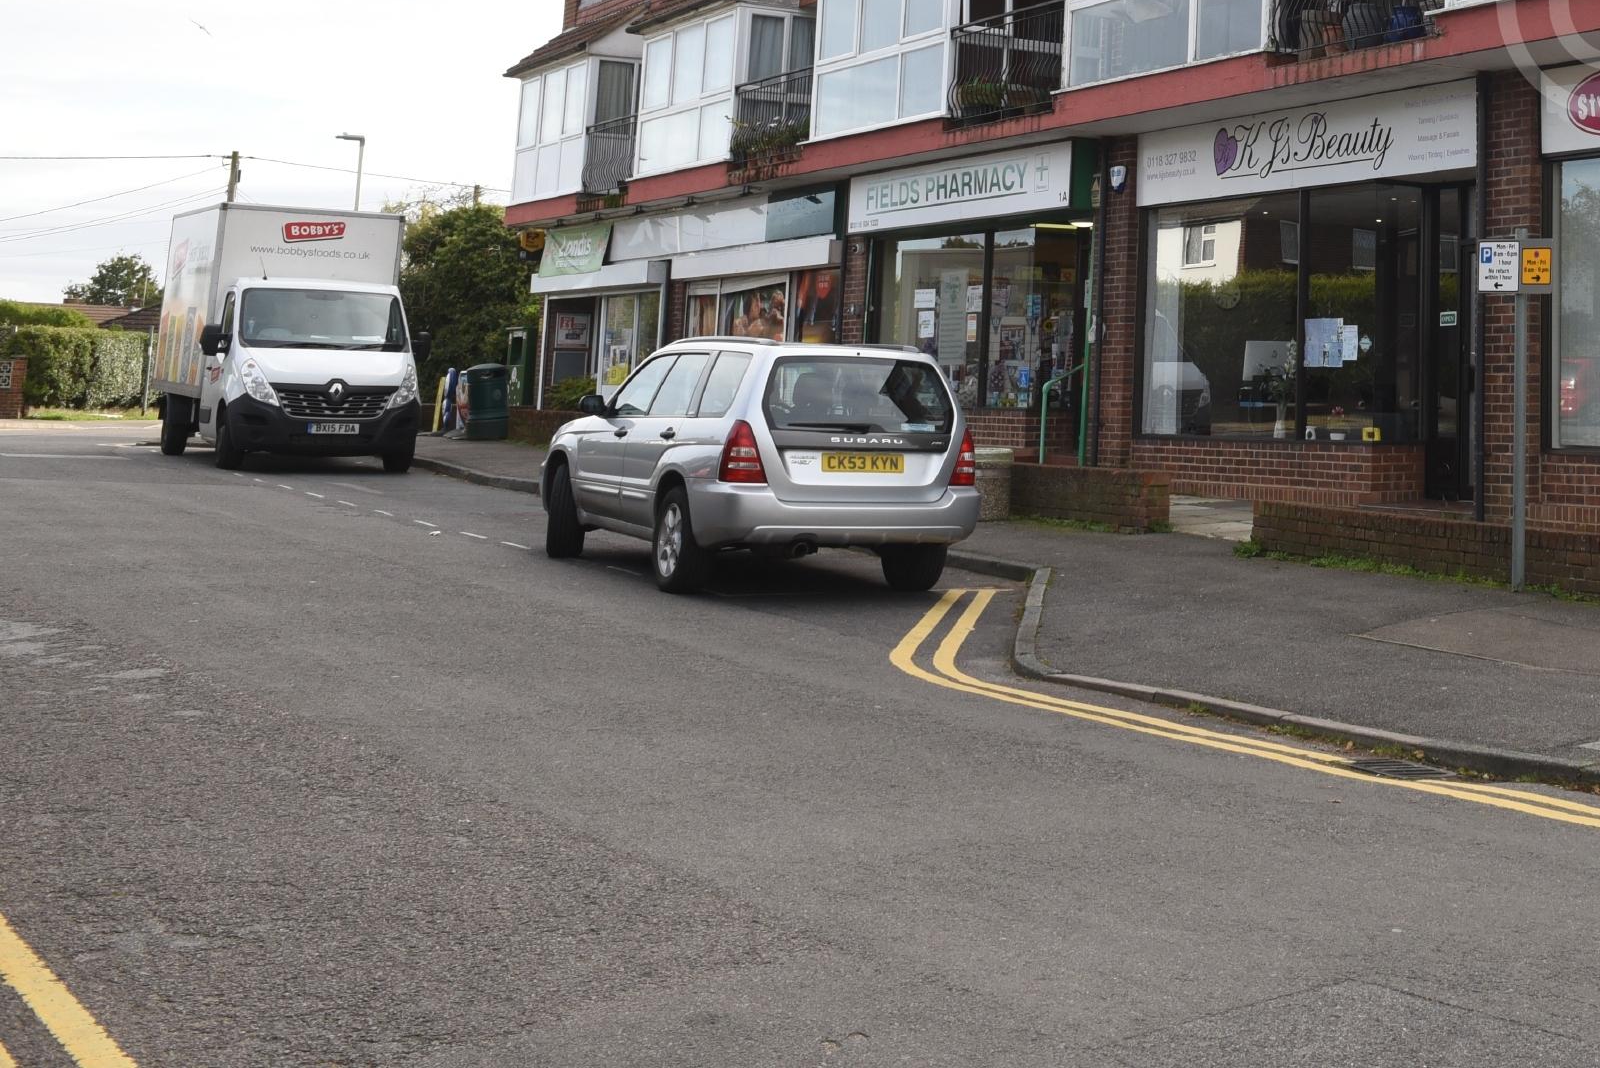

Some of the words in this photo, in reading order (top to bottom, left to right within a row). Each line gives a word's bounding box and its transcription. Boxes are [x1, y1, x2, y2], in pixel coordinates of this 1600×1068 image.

[1294, 112, 1394, 171] Beauty
[1147, 155, 1163, 168] 0118
[1164, 153, 1177, 165] 327
[1179, 150, 1197, 163] 9832
[866, 181, 920, 211] FIELDS
[925, 162, 1028, 202] PHARMACY
[1059, 191, 1068, 203] 1A
[290, 224, 340, 236] BOBBY'S
[250, 245, 371, 260] www.bobbysfoods.co.uk
[830, 437, 903, 445] SUBARU
[827, 455, 866, 470] CK53
[871, 456, 899, 471] KYN
